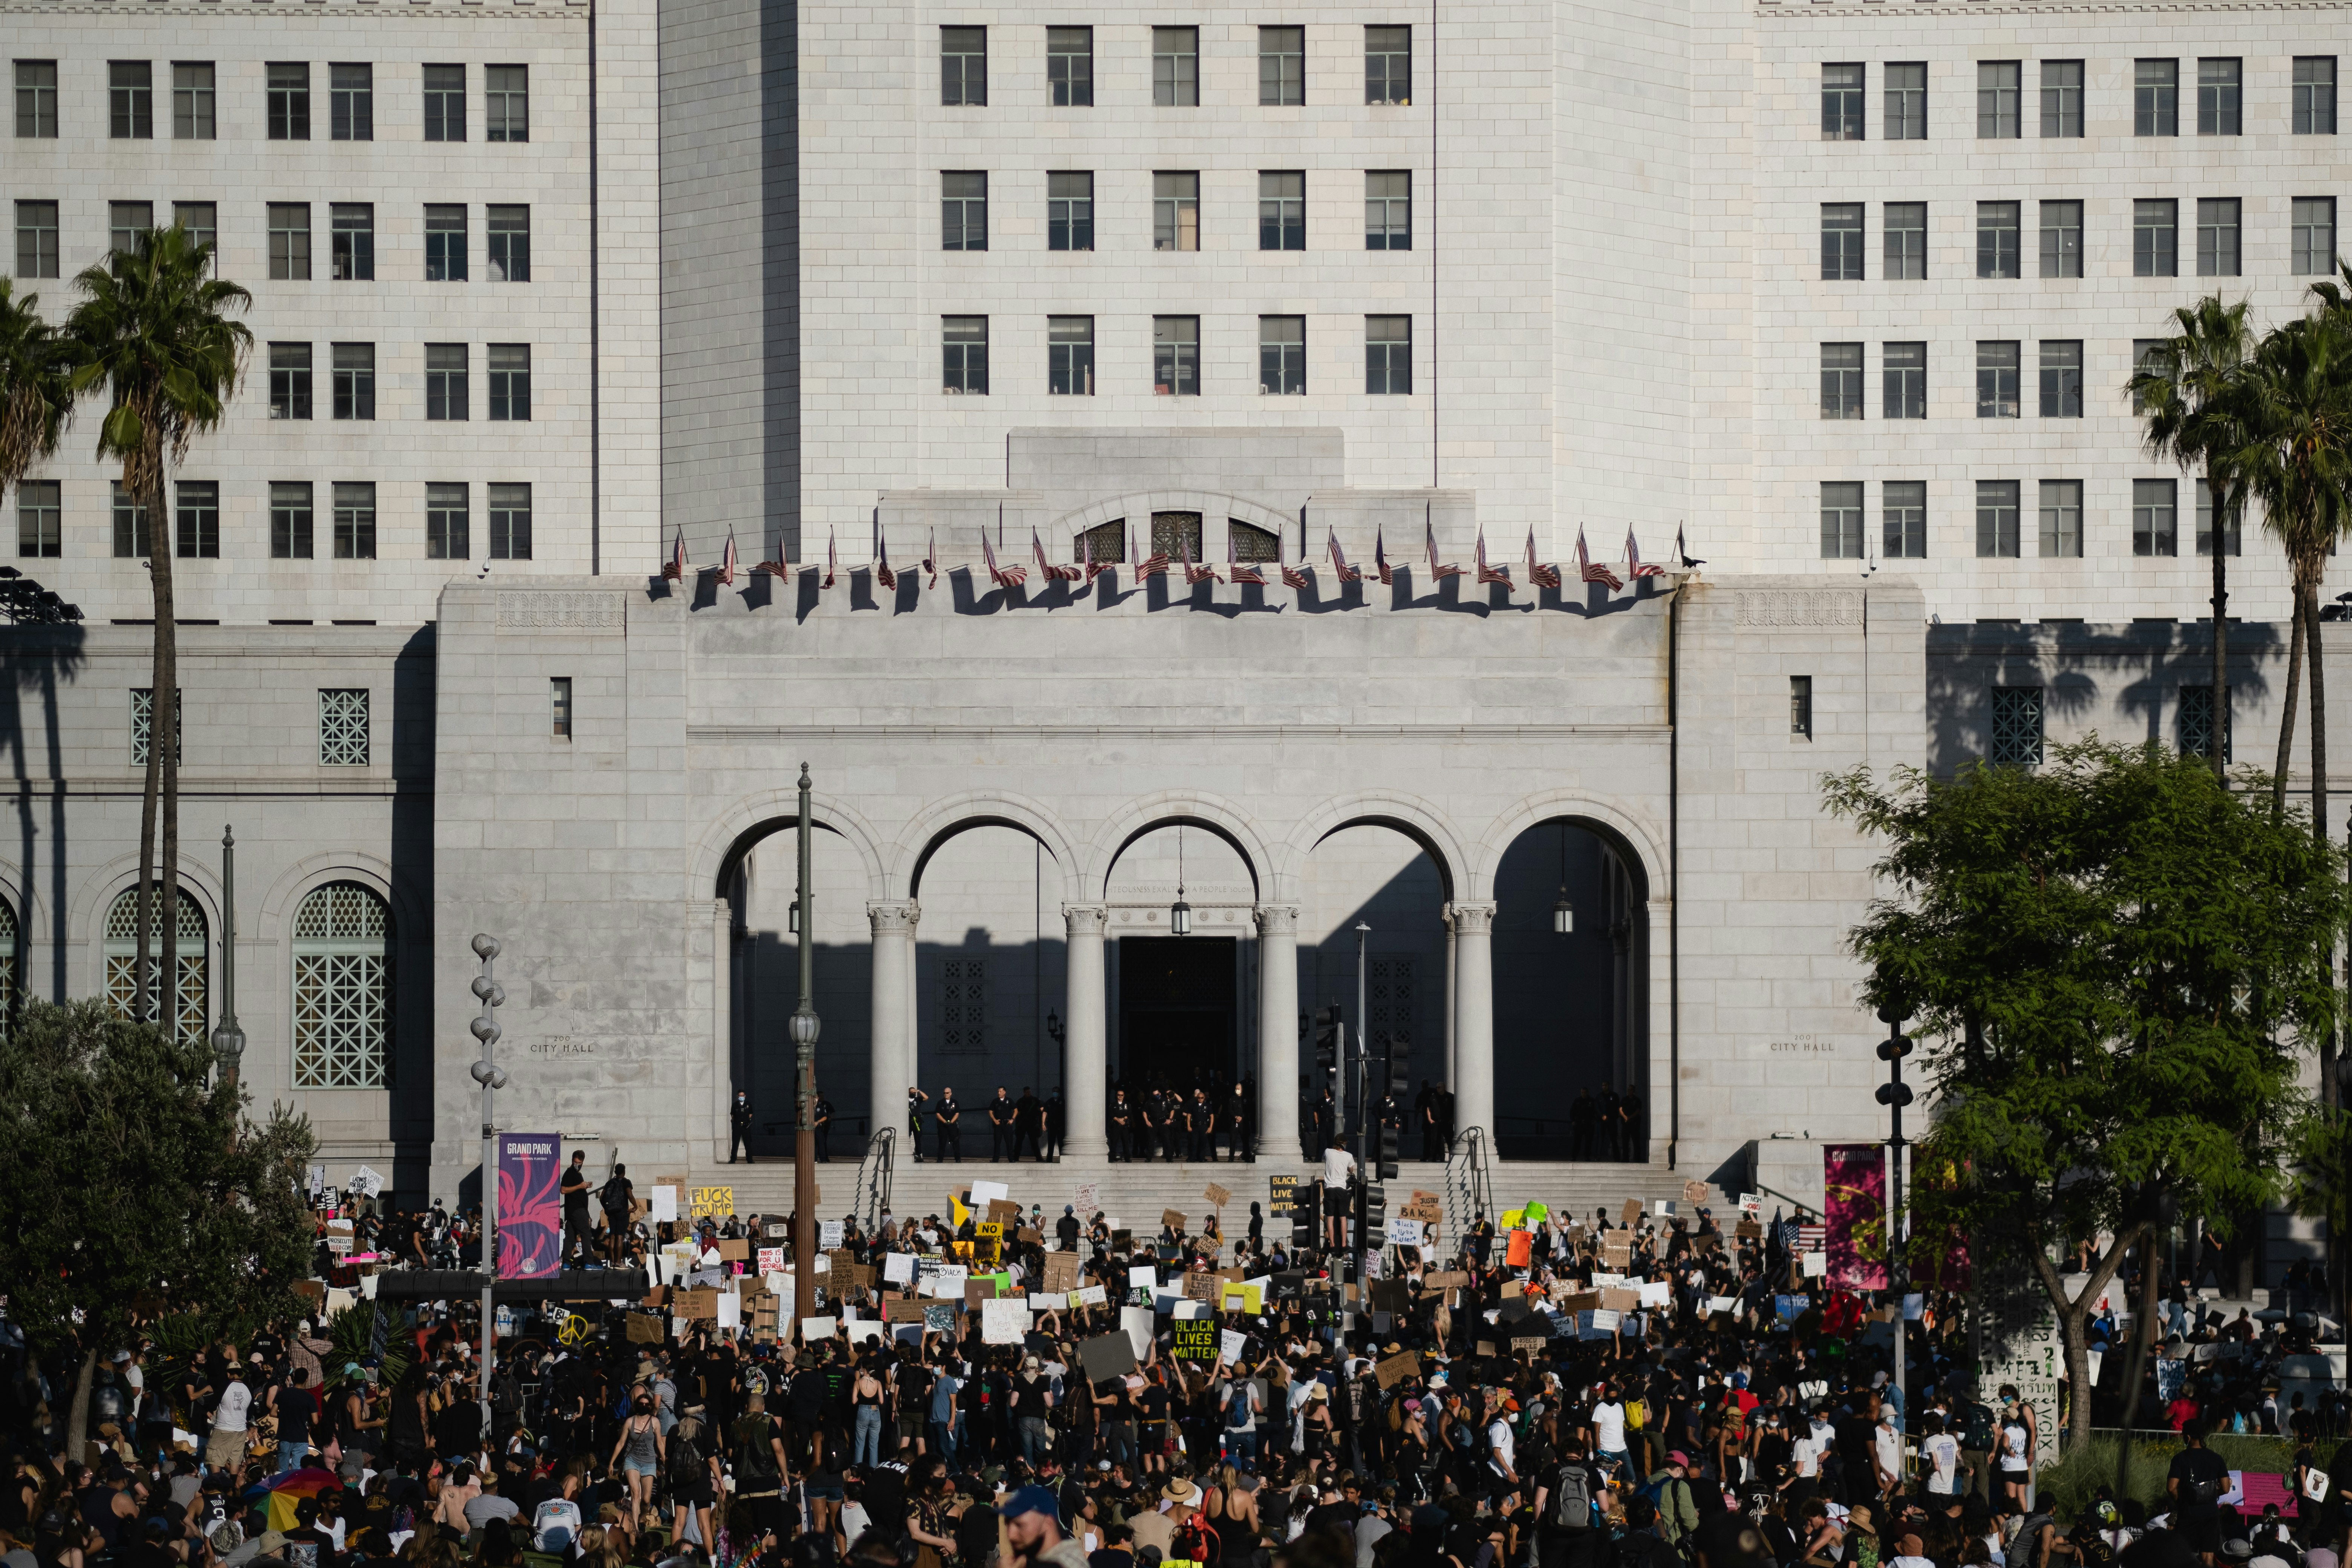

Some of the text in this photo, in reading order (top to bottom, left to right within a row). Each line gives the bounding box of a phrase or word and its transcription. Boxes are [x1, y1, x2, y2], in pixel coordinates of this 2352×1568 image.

[507, 1143, 552, 1154] GRAND PARK
[1832, 1151, 1876, 1162] GRAND PARK
[1272, 1176, 1297, 1185] BLACK
[323, 1187, 337, 1210] NAME
[691, 1188, 732, 1204] FUCK
[1273, 1189, 1293, 1198] LIVE
[691, 1203, 731, 1216] TRUMP
[982, 1225, 997, 1233] NO
[1201, 1240, 1215, 1254] LIVES
[1203, 1235, 1219, 1249] BLACK
[329, 1267, 356, 1287] BLM
[1191, 1282, 1214, 1290] LIVES
[999, 1289, 1024, 1297] BLACK
[1188, 1288, 1215, 1298] MATTER
[986, 1300, 1020, 1312] ASKING
[1002, 1311, 1007, 1320] 4
[988, 1317, 1011, 1328] Justi
[1175, 1320, 1214, 1332] BLACK
[989, 1333, 1015, 1341] CRIME
[1177, 1333, 1212, 1344] LIVES
[1173, 1346, 1218, 1359] MATTER
[1377, 1355, 1410, 1375] PROSECUTE
[2159, 1361, 2184, 1370] STOP
[1386, 1367, 1405, 1380] KILLER
[2161, 1388, 2178, 1400] COP
